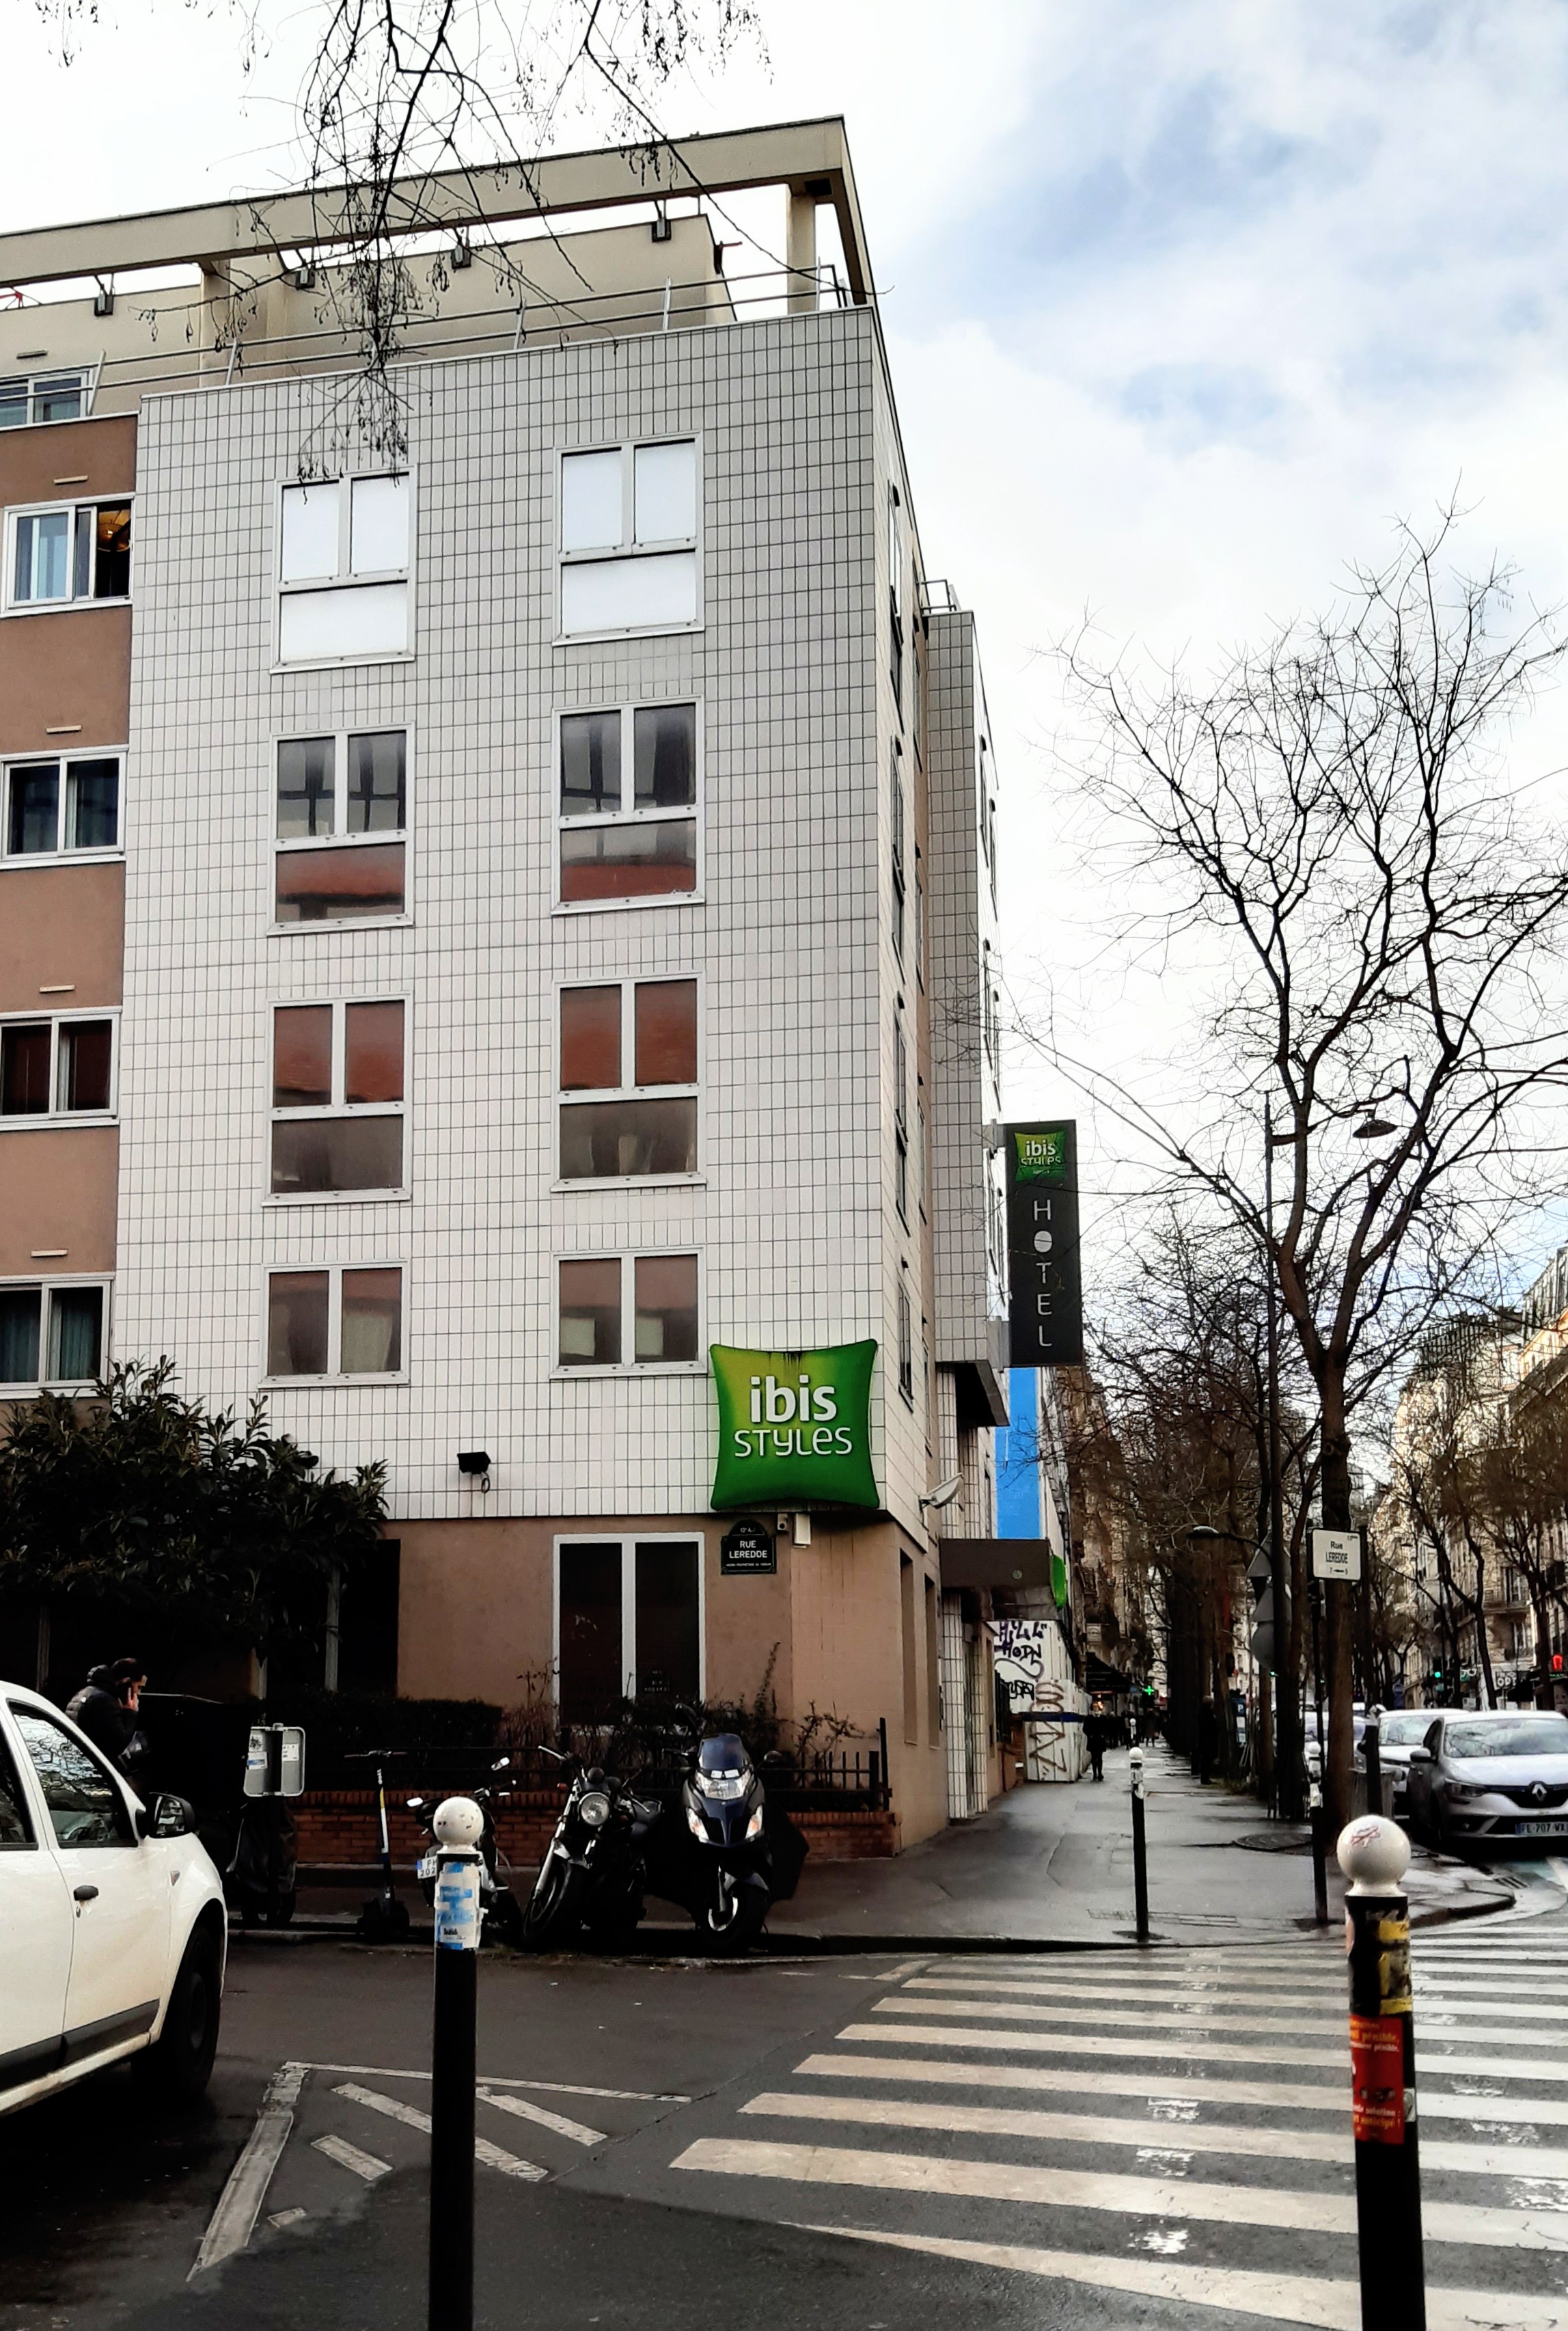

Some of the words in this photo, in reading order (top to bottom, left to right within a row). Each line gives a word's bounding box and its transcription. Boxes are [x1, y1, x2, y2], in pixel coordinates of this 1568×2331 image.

[1026, 1139, 1056, 1156] ibis
[750, 1374, 838, 1423] ibis
[740, 1540, 756, 1549] RUE
[1330, 1540, 1343, 1549] Rue
[729, 1550, 768, 1558] LEREDDE
[1326, 1552, 1348, 1564] LEREDDE
